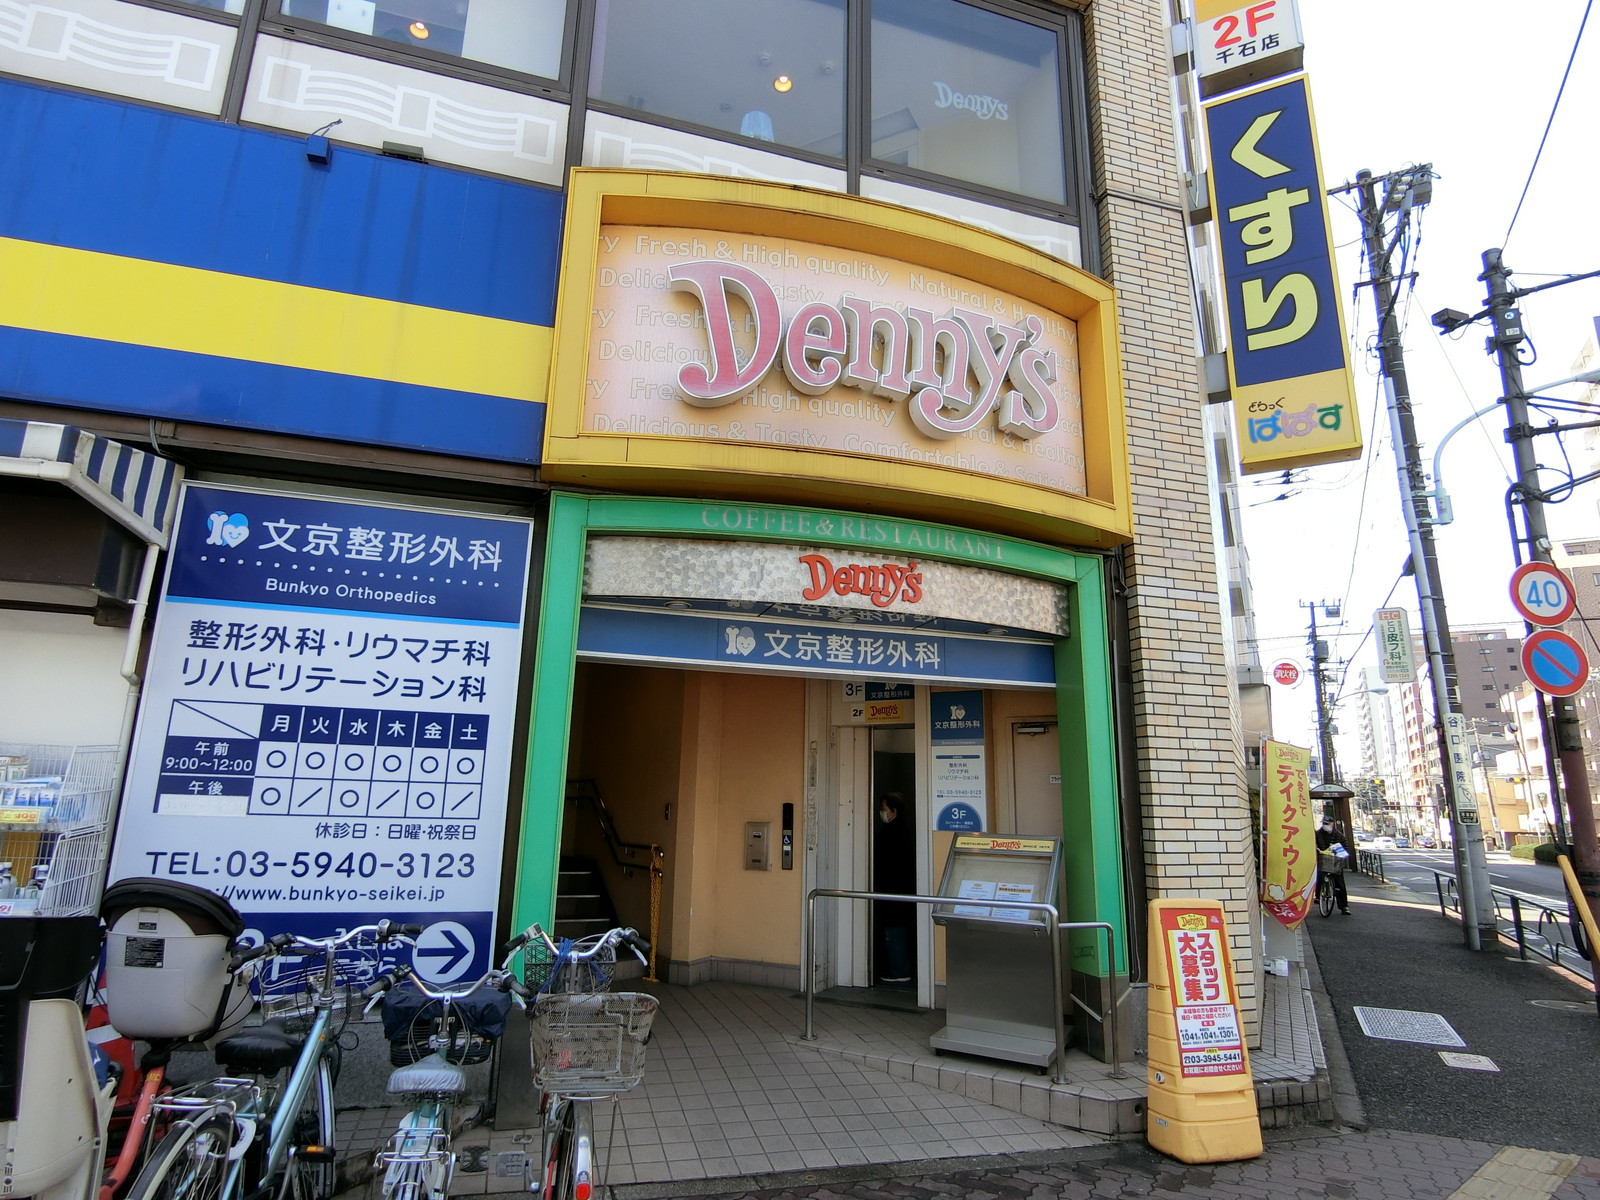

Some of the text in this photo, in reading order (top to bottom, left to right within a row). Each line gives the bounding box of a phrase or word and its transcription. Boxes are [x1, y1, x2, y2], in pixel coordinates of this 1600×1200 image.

[1213, 1, 1276, 49] 2F
[1216, 33, 1279, 64] 千石店
[1228, 110, 1319, 351] くすり
[636, 234, 707, 258] Fresh
[714, 240, 735, 261] &
[742, 242, 804, 269] High
[805, 255, 890, 286] quality
[909, 272, 988, 309] Natural
[993, 297, 1007, 317] &
[599, 340, 711, 365] Deliciou
[667, 259, 1060, 440] Denny's
[593, 414, 720, 438] Delicious
[726, 421, 747, 440] &
[755, 423, 827, 448] Tasty
[742, 386, 800, 413] High
[808, 398, 896, 427] quality
[1002, 430, 1016, 450] &
[1248, 403, 1344, 443] ぱぱす
[258, 517, 502, 573] 文京整形外科
[265, 577, 437, 606] Bunkyo Orthopedics
[799, 553, 923, 608] Denny's
[1526, 580, 1562, 608] 40
[186, 619, 491, 668] 整形外科・リウマチ科
[763, 630, 941, 670] 文京整形外科
[181, 656, 487, 703] リハビリテーション科
[845, 683, 862, 697] 3F
[1275, 668, 1298, 680] 消火栓
[271, 714, 479, 741] 月 火 水 木 金 土
[852, 704, 898, 717] 2F Denny's
[935, 720, 980, 729] 文京整形外科
[195, 741, 230, 757] 午前
[188, 779, 224, 796] 午後
[1296, 769, 1307, 817] できたて
[951, 808, 966, 819] 3F
[1276, 765, 1300, 890] テイクアウト
[991, 840, 1021, 850] Denny's
[146, 850, 475, 878] TEL:03-5940-3123
[1177, 932, 1205, 1001] 大募集
[1196, 933, 1220, 1001] スタッフ
[1190, 1053, 1240, 1064] 03-3945-5441
